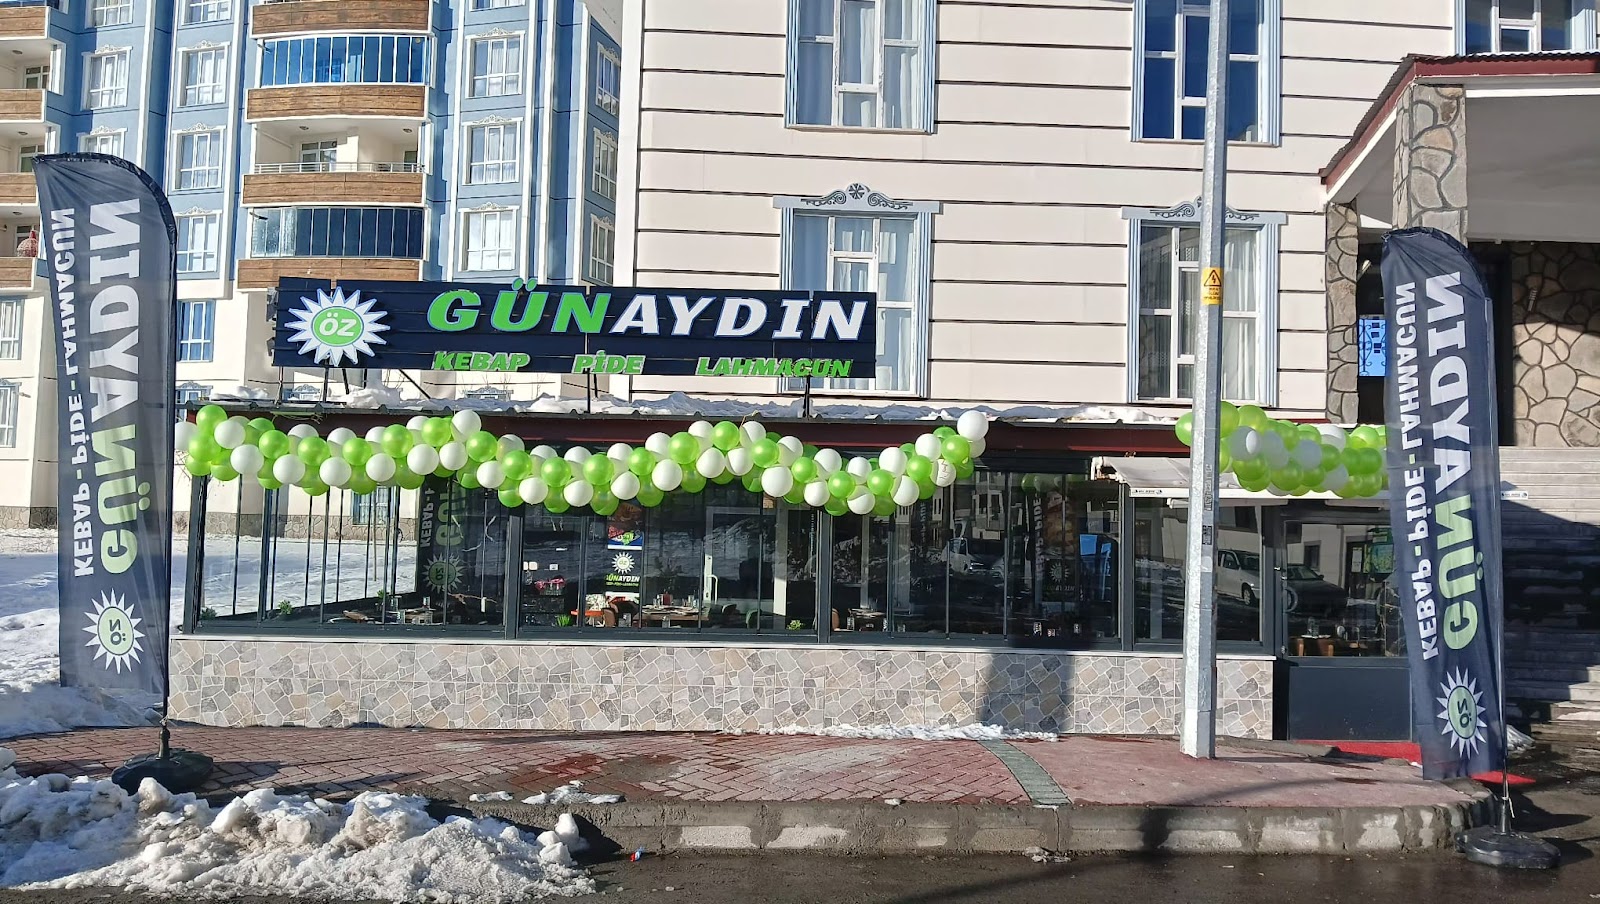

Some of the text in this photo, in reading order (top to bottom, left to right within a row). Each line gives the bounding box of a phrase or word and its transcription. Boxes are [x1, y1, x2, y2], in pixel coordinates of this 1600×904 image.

[427, 277, 868, 341] GÜNAYDIN
[319, 311, 357, 337] ÖZ
[431, 349, 854, 378] KEBAP PİDE LAHMACUN
